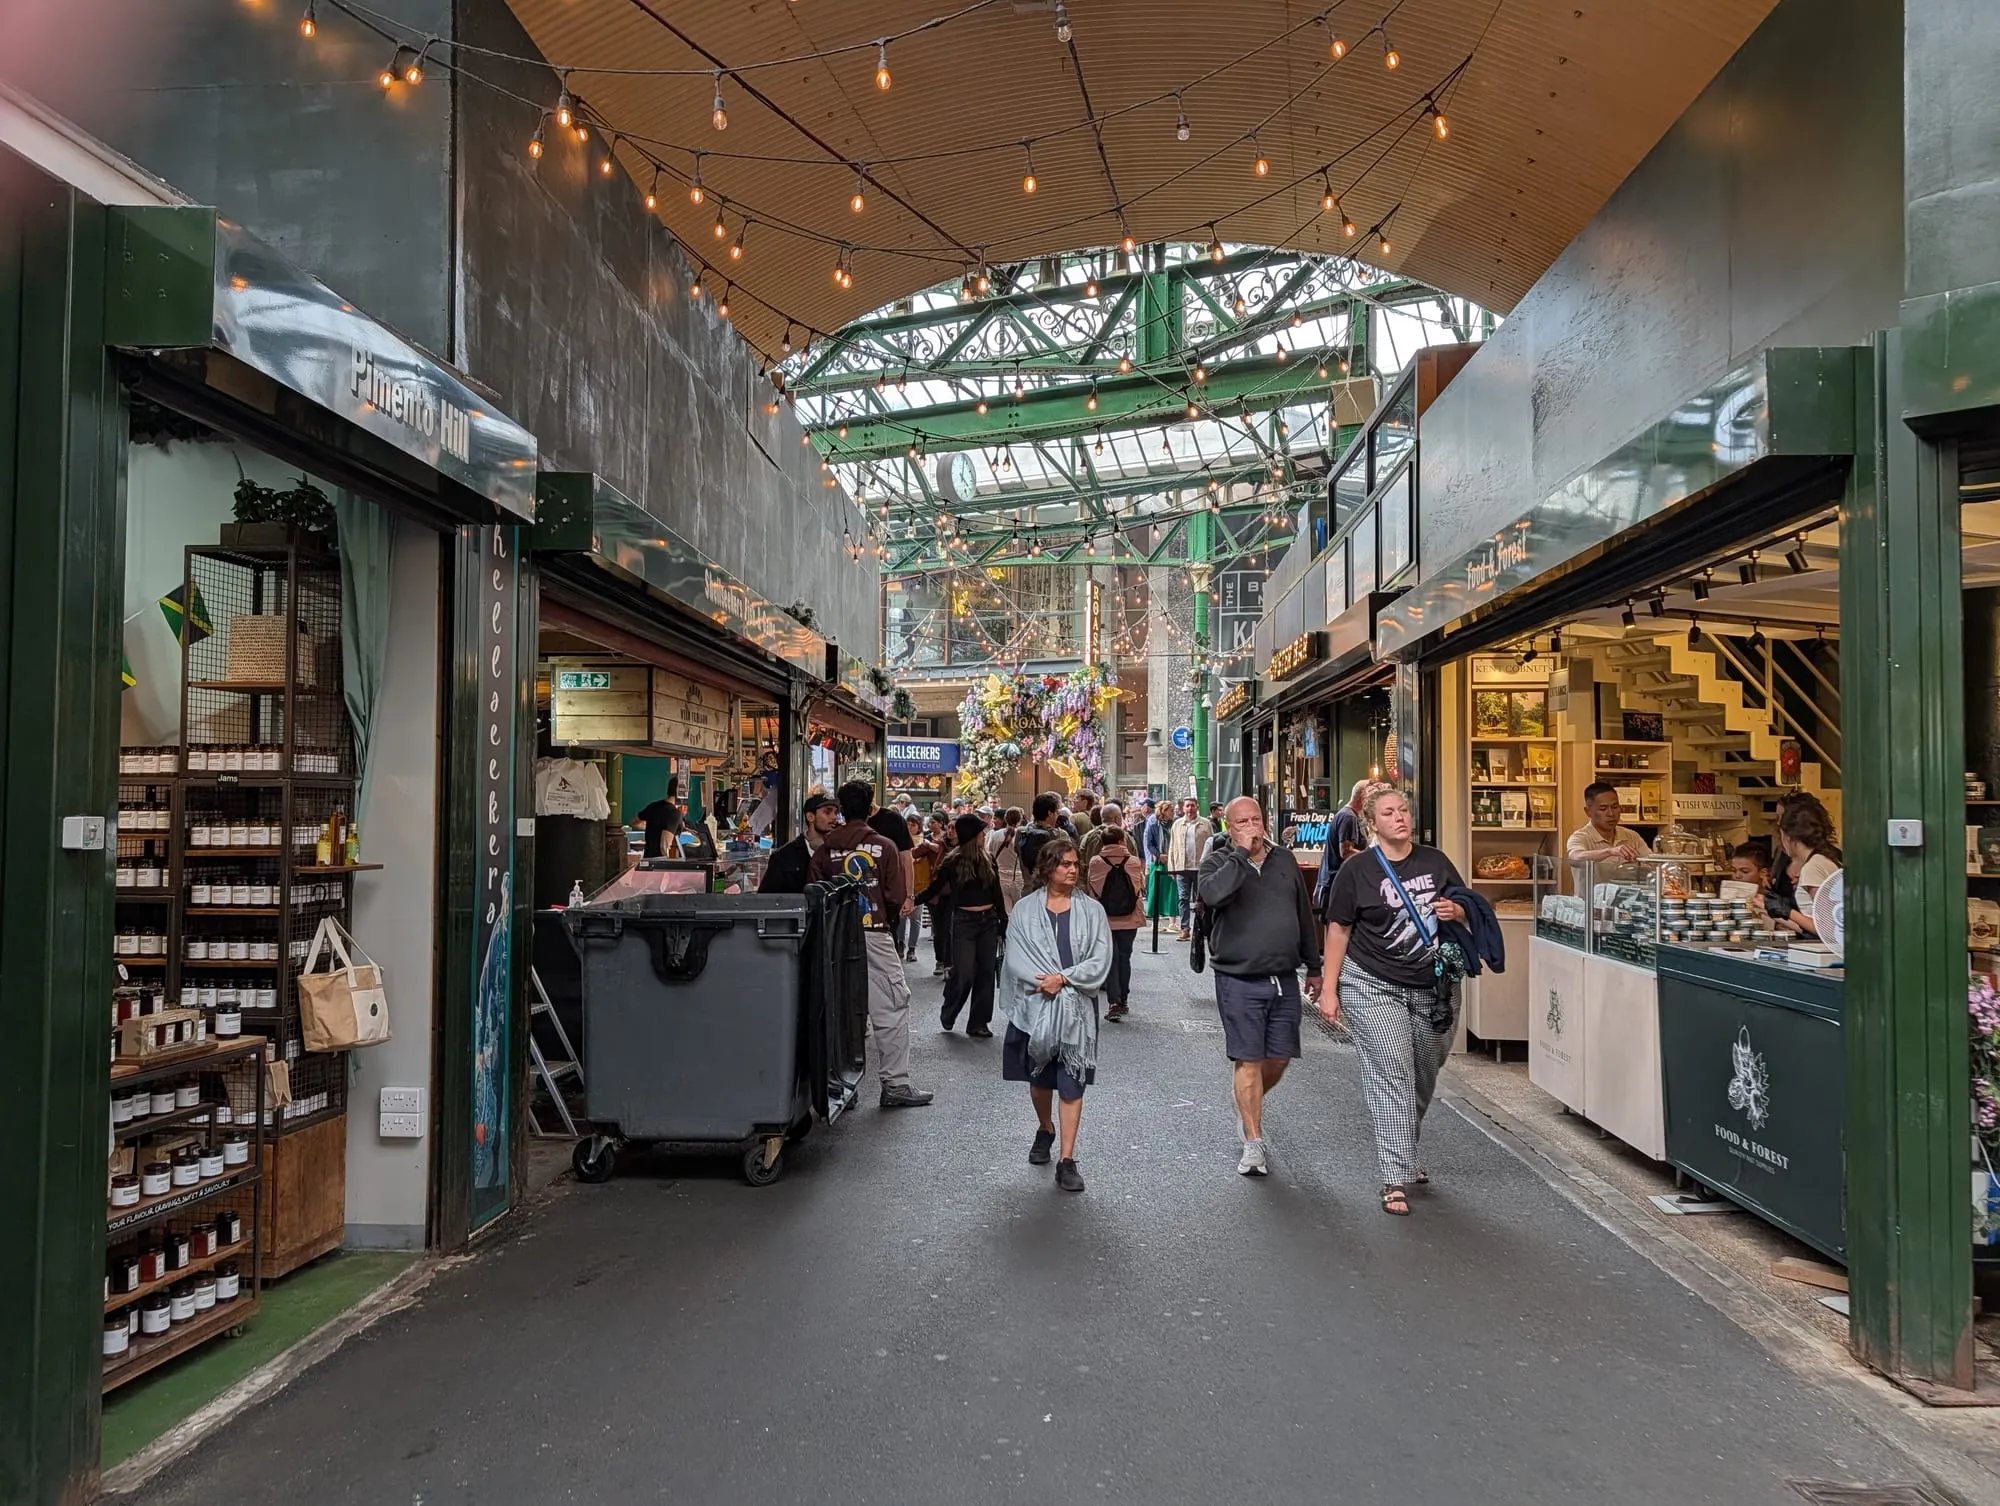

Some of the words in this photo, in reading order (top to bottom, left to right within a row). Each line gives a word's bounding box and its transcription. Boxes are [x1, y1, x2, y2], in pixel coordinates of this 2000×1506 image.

[351, 350, 435, 437] Pimento
[440, 399, 470, 465] Hill
[1465, 552, 1486, 591] Food
[1497, 528, 1527, 573] Forest
[1225, 582, 1234, 606] THE
[1475, 664, 1503, 673] KENT
[1505, 663, 1553, 673] COBNUTS
[486, 522, 506, 924] hellseekers
[887, 744, 941, 761] HELLSEEKERS
[218, 774, 239, 783] Jams
[1680, 800, 1700, 810] TISH
[1701, 799, 1742, 810] WALNUTS
[1311, 812, 1328, 824] Day
[1328, 812, 1335, 822] B
[1296, 822, 1330, 844] Whit
[1379, 872, 1436, 908] BWIE
[1715, 1123, 1741, 1146] FOOD
[1742, 1138, 1750, 1150] &
[1751, 1141, 1789, 1169] FOREST
[108, 1218, 126, 1231] YOUR
[126, 1208, 155, 1225] FLAVOUR
[203, 1180, 230, 1196] SAVOURY
